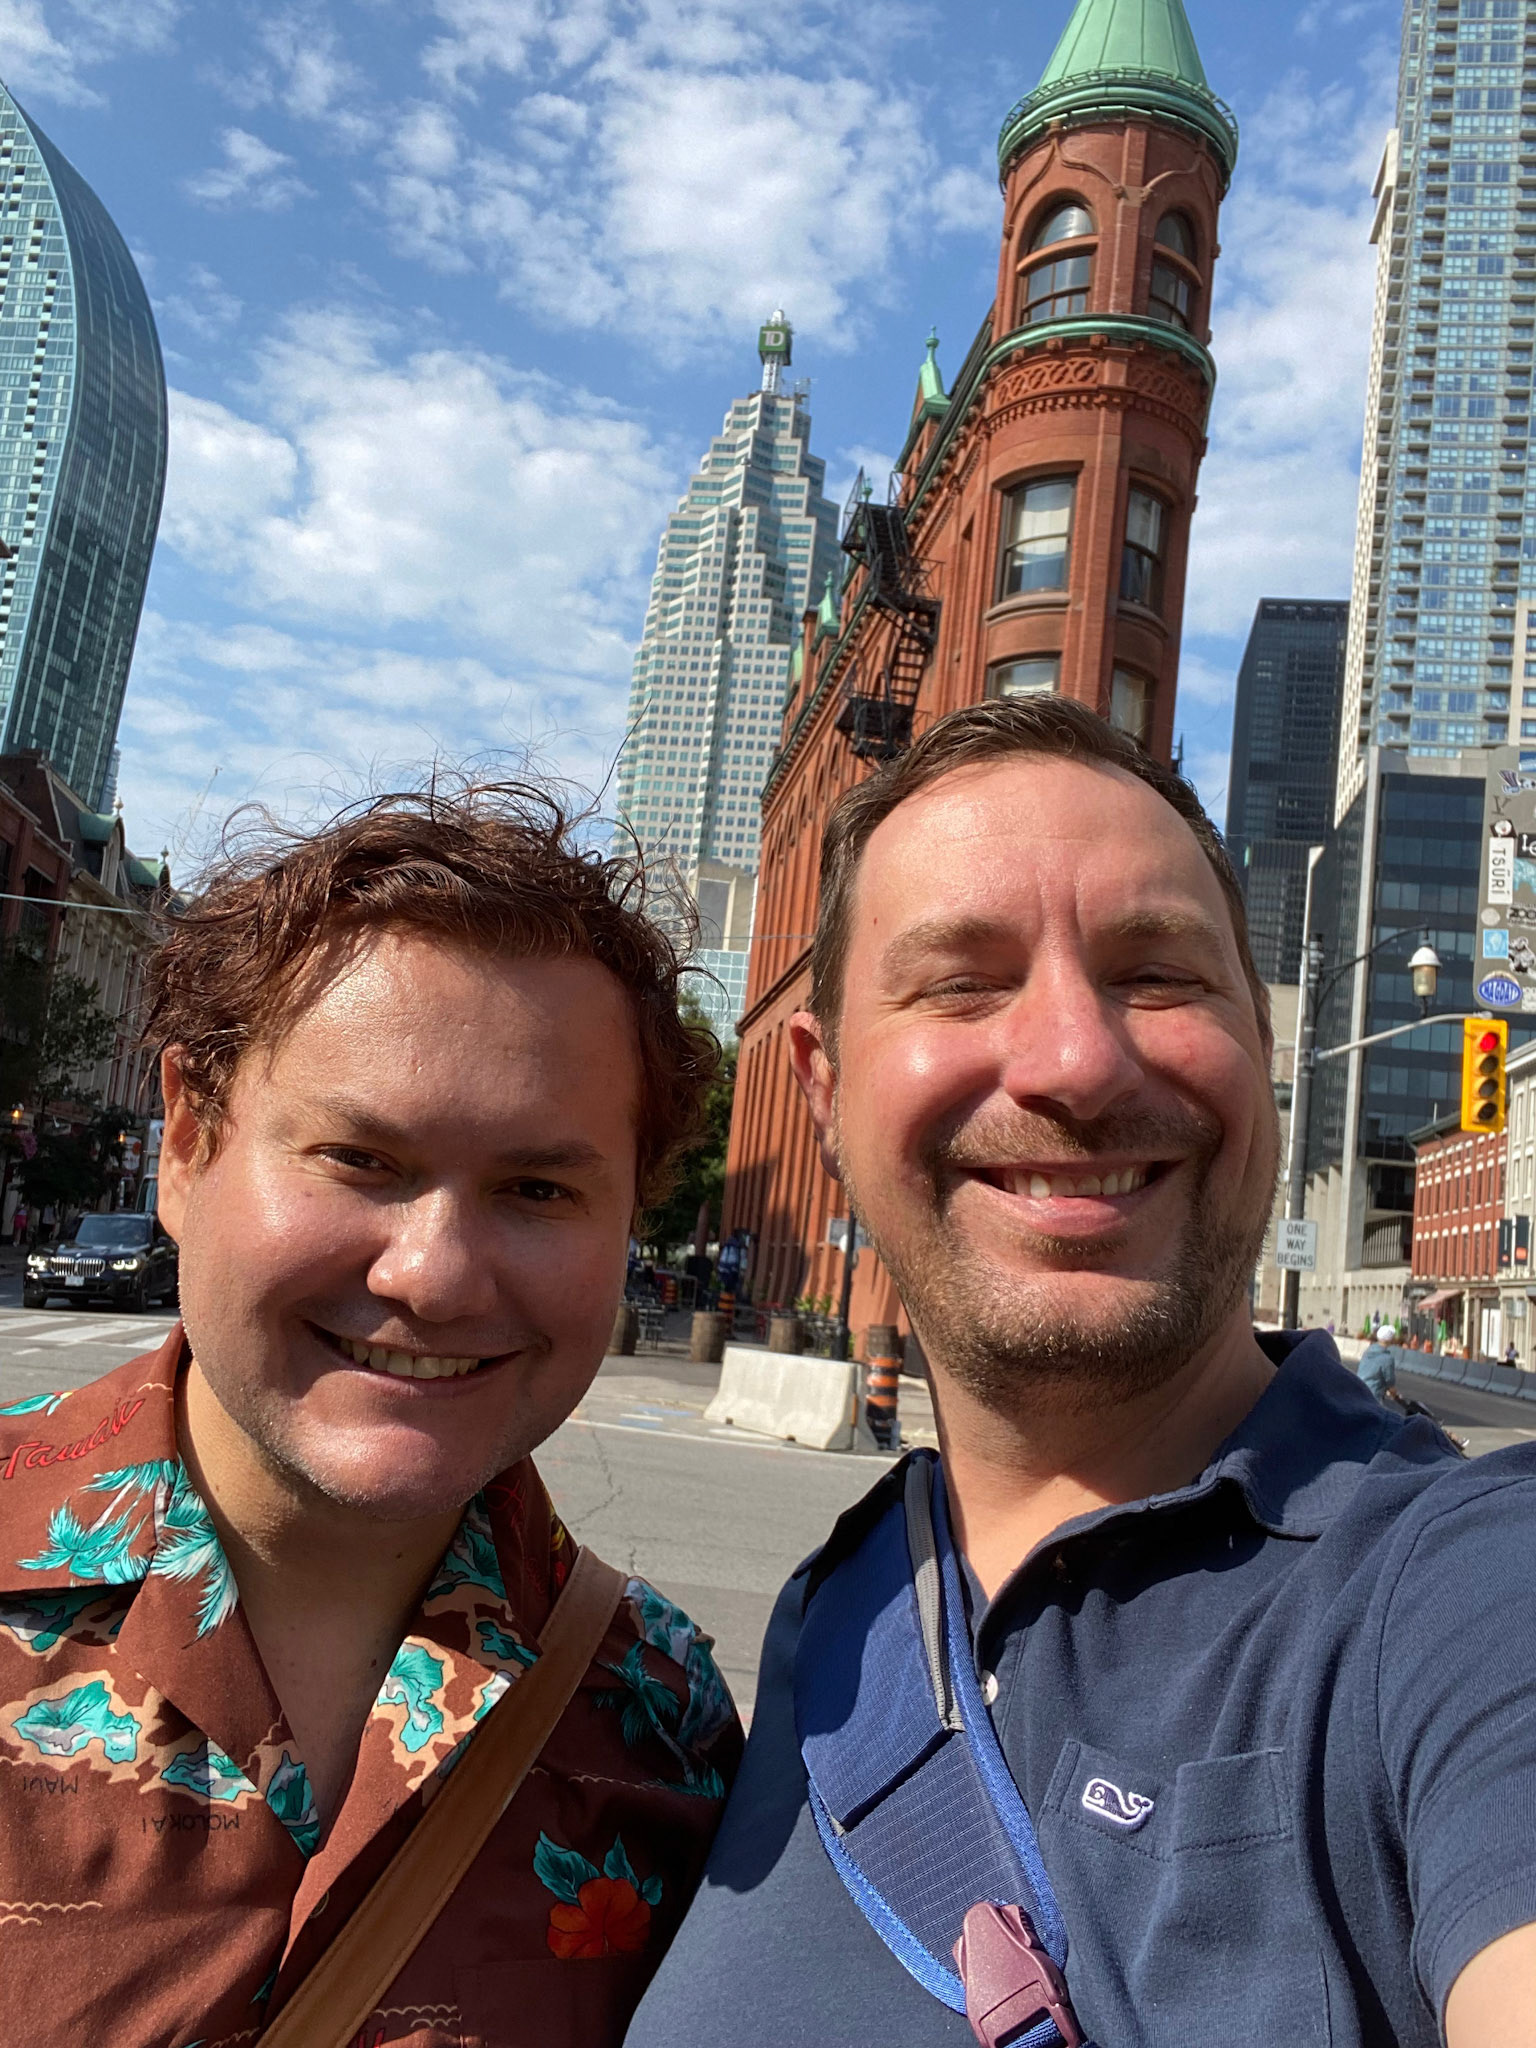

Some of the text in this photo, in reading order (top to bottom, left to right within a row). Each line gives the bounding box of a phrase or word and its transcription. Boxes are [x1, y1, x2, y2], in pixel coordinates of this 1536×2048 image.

[762, 331, 785, 346] TD
[1287, 1223, 1307, 1236] ONE
[1287, 1239, 1306, 1250] WAY
[1277, 1252, 1313, 1266] BEGINS
[23, 1776, 78, 1794] MAUI
[142, 1813, 240, 1833] MOLOKAI
